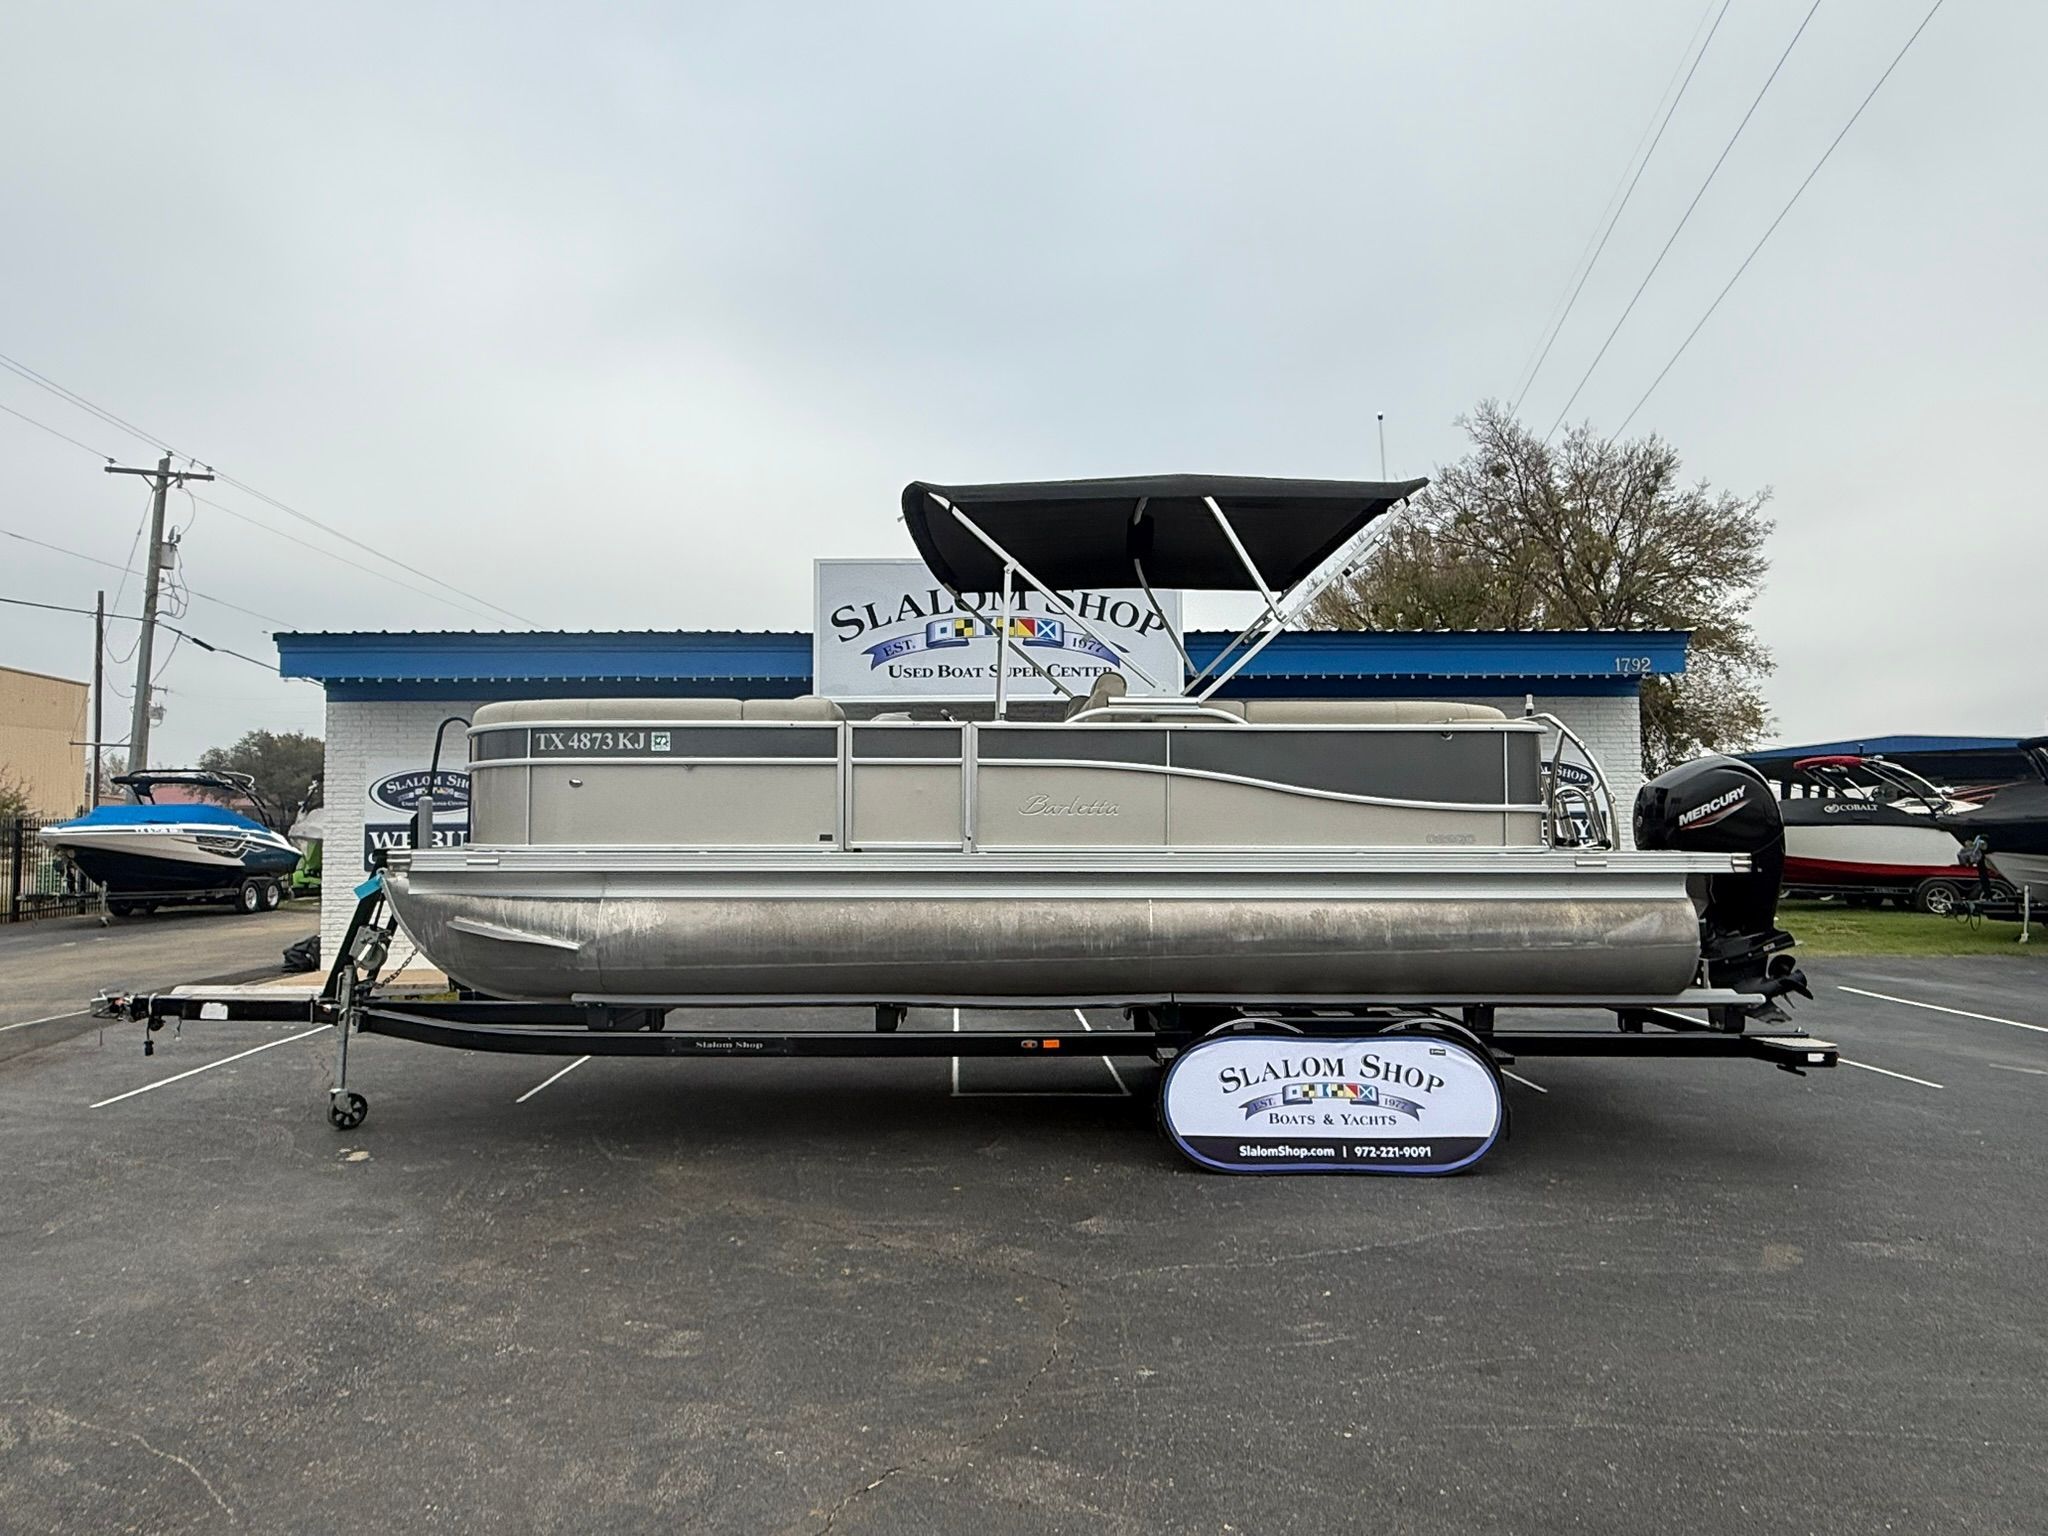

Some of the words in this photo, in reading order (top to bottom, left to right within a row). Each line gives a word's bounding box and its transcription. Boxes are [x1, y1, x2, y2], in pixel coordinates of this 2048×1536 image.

[830, 588, 1029, 643] SLALOM
[1045, 589, 1166, 637] SHOP
[882, 639, 916, 657] EST.
[1072, 637, 1103, 653] 1977
[888, 664, 934, 679] USED
[937, 664, 984, 679] BOAT
[1614, 657, 1651, 673] 1792
[535, 732, 566, 750] TX
[567, 731, 614, 750] 4873
[617, 732, 646, 750] KJ
[1018, 793, 1121, 817] Barletta
[1678, 784, 1746, 826] MERCURY
[1840, 803, 1878, 812] COBALT
[696, 1041, 733, 1049] Slalom
[735, 1041, 763, 1050] Shop
[1218, 1056, 1346, 1094] SLALOM
[1359, 1053, 1445, 1094] SHOP
[1252, 1098, 1277, 1111] EST.
[1383, 1097, 1408, 1111] 1977
[1268, 1113, 1316, 1126] BOATS
[1322, 1113, 1335, 1126] &
[1340, 1113, 1398, 1127] YACHTS
[1239, 1144, 1336, 1159] SlalomShop.com
[1353, 1145, 1432, 1158] 972-221-9091
